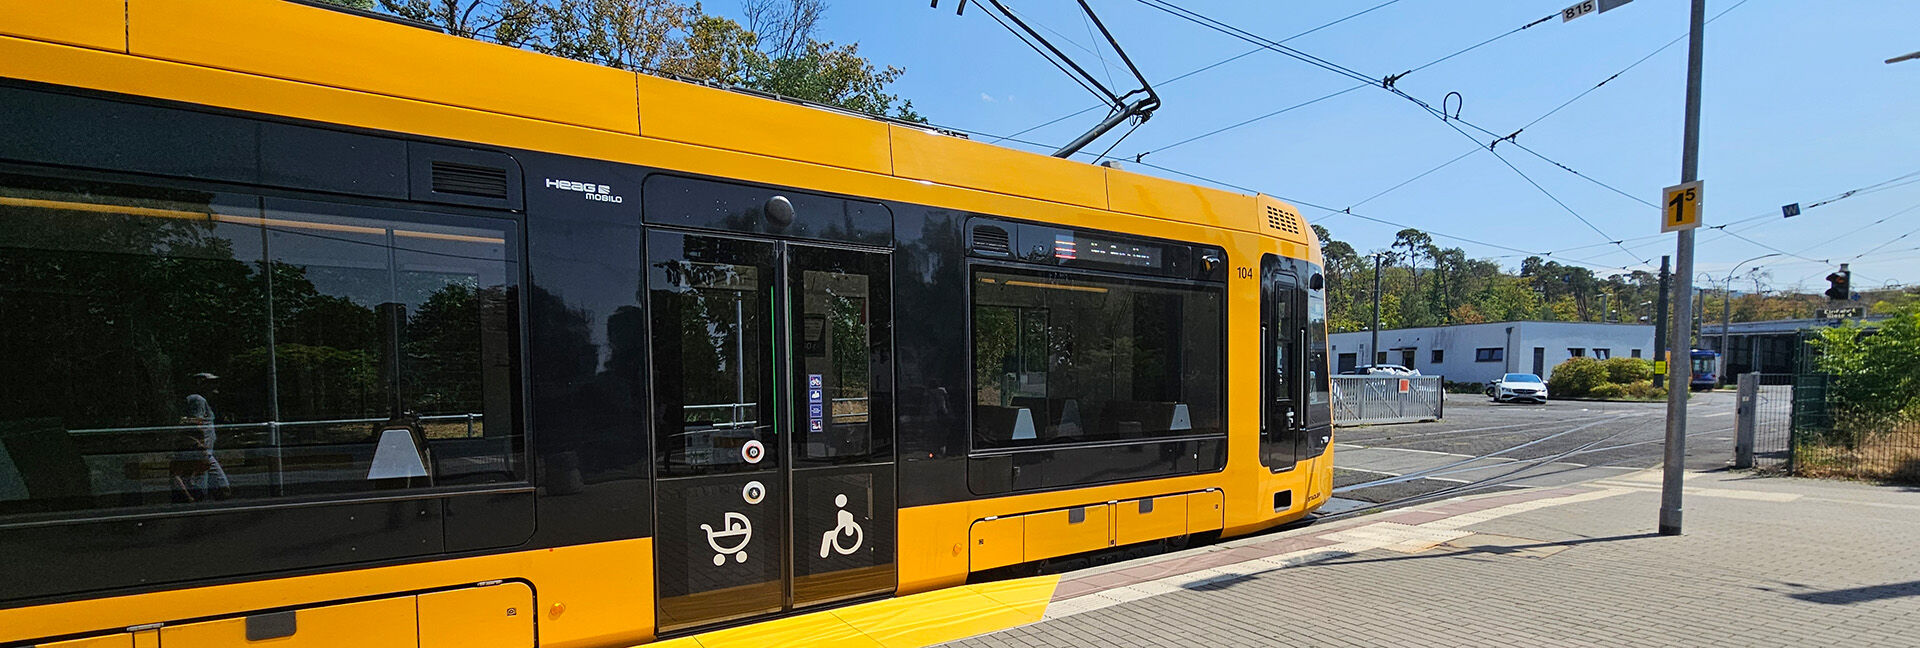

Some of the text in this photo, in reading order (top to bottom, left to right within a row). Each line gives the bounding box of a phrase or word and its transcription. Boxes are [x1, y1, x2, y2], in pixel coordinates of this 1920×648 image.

[1565, 0, 1592, 19] 815
[1784, 205, 1797, 215] W
[1237, 267, 1252, 280] 104
